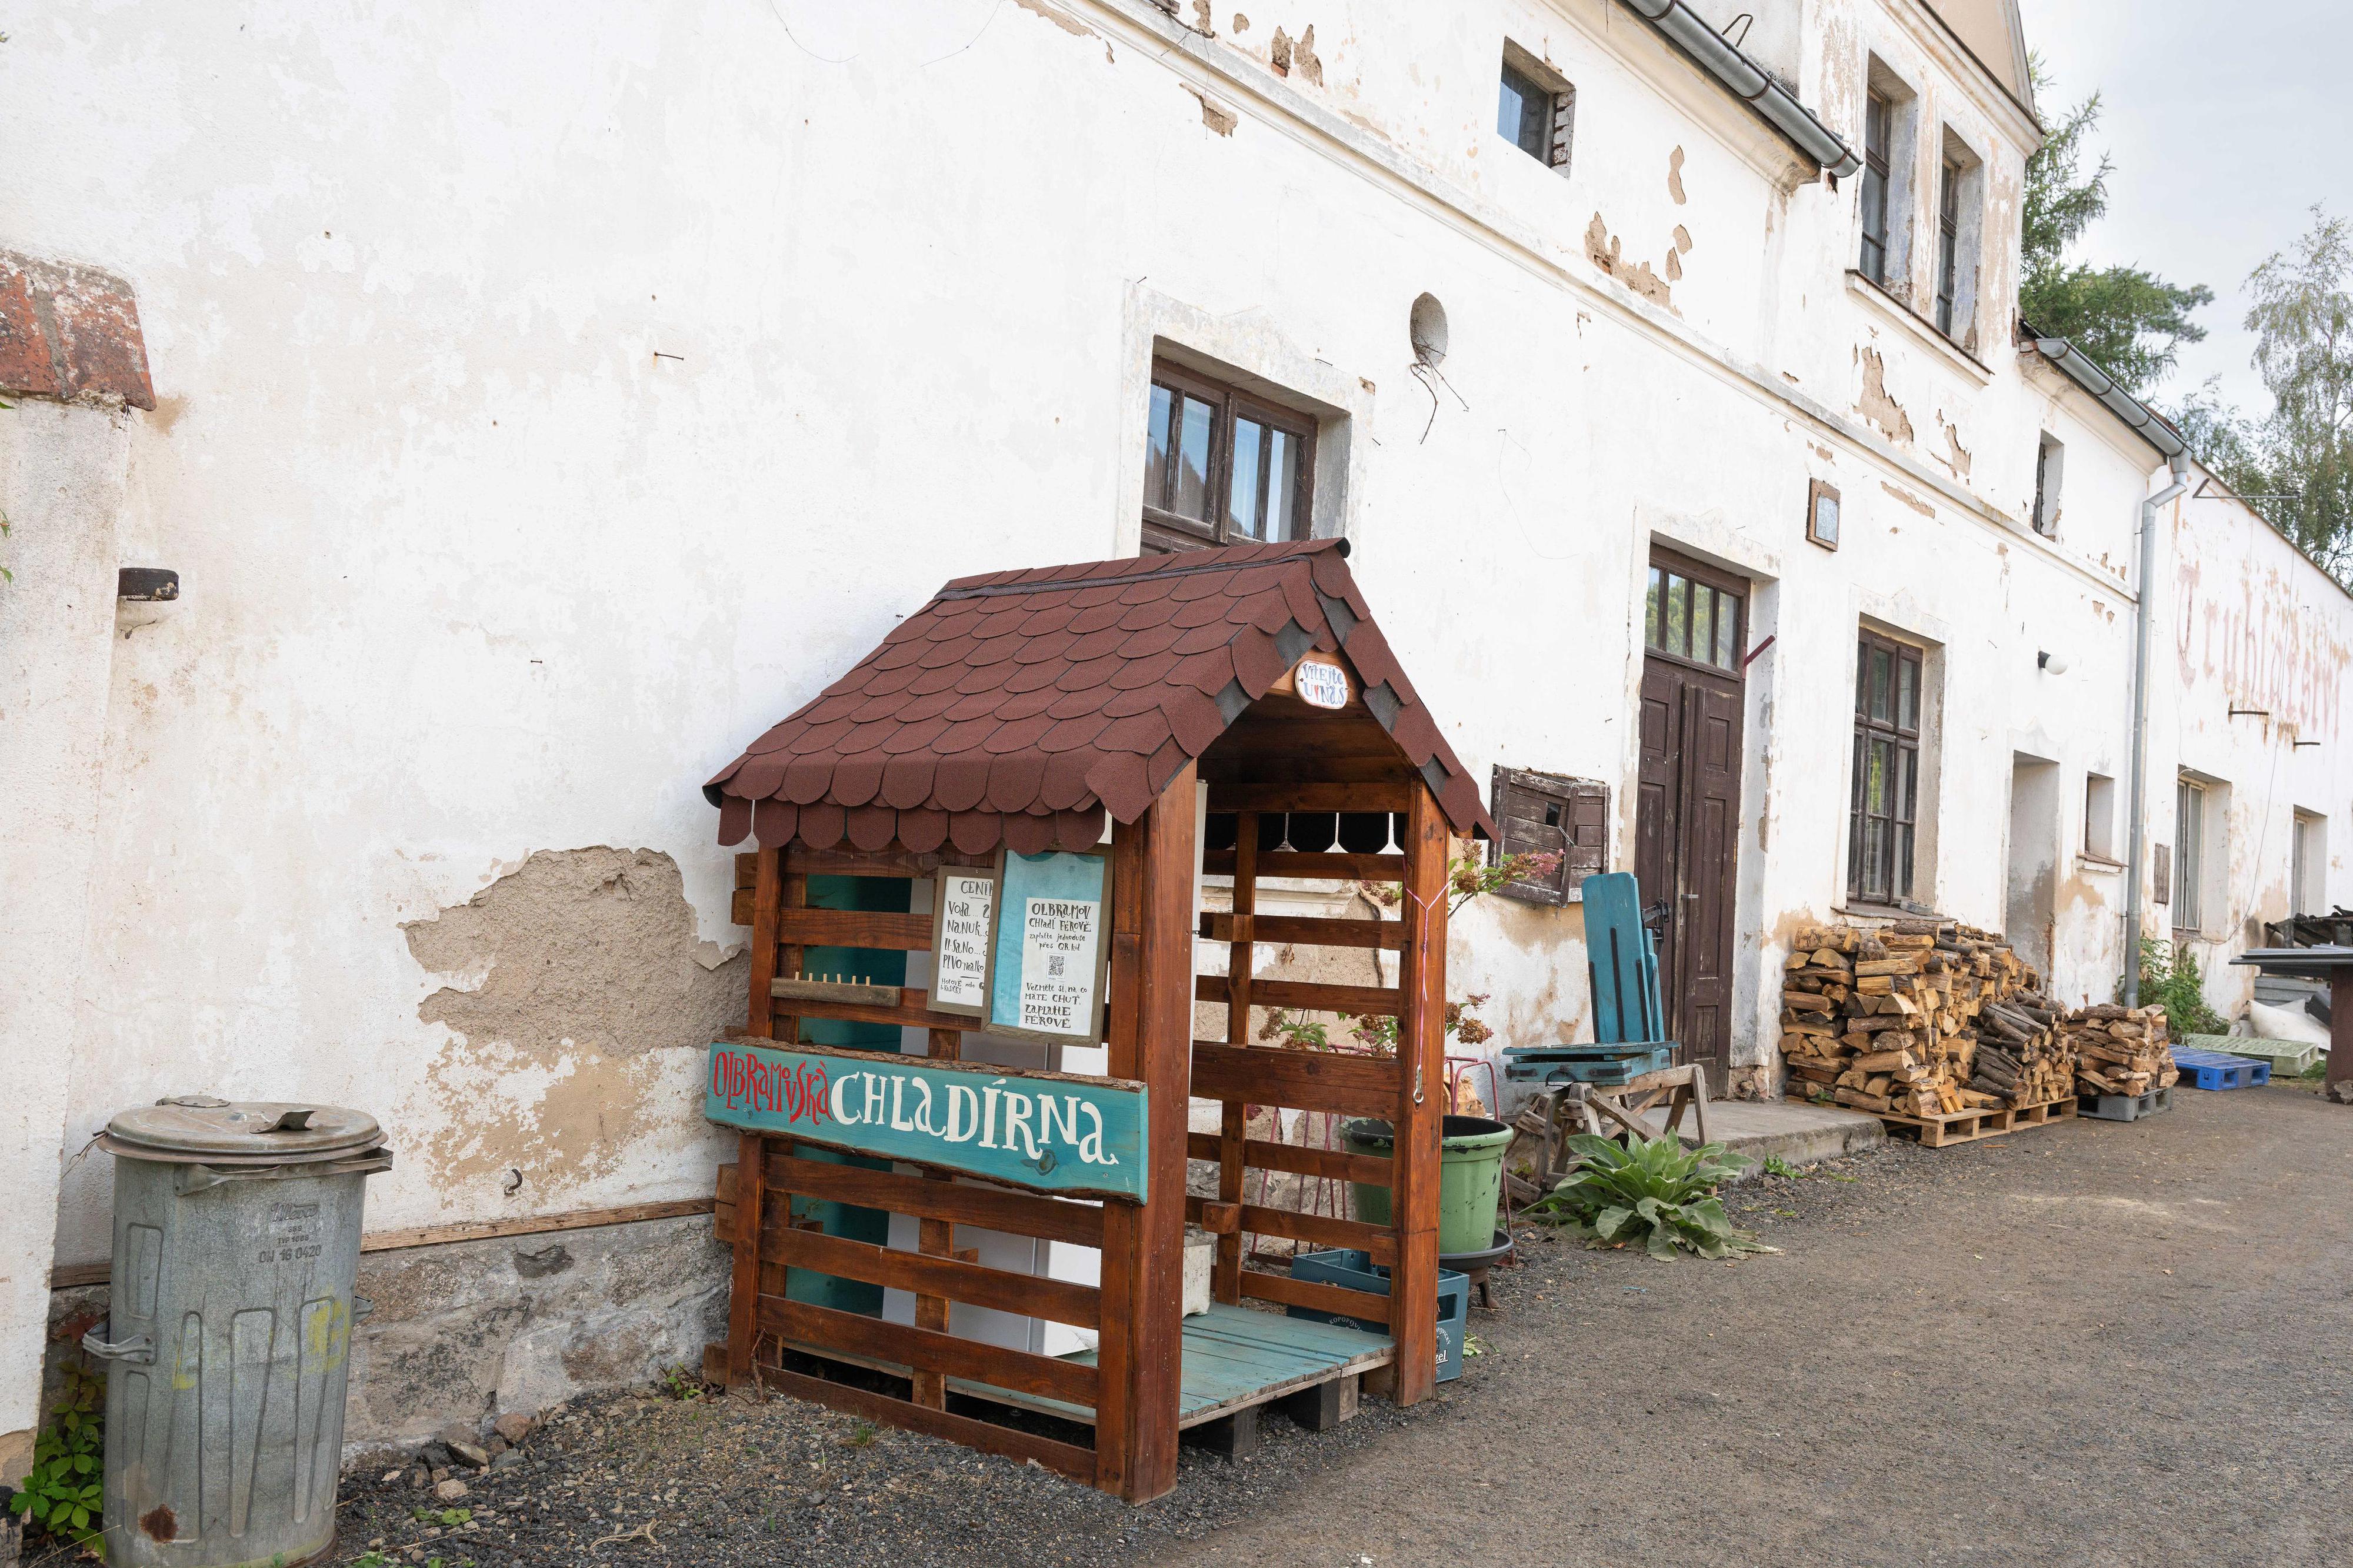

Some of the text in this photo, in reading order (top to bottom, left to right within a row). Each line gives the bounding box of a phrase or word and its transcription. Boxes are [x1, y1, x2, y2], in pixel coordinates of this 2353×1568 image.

[1304, 682, 1314, 696] U
[948, 900, 971, 916] Voda
[982, 903, 990, 918] 2
[1059, 920, 1092, 932] FÉROVĚ
[1039, 942, 1054, 950] přes
[942, 954, 962, 969] PIVO
[1025, 1015, 1071, 1028] FÉROVĚ
[1329, 1317, 1362, 1331] KOPOPOVI
[1436, 1349, 1447, 1362] zel
